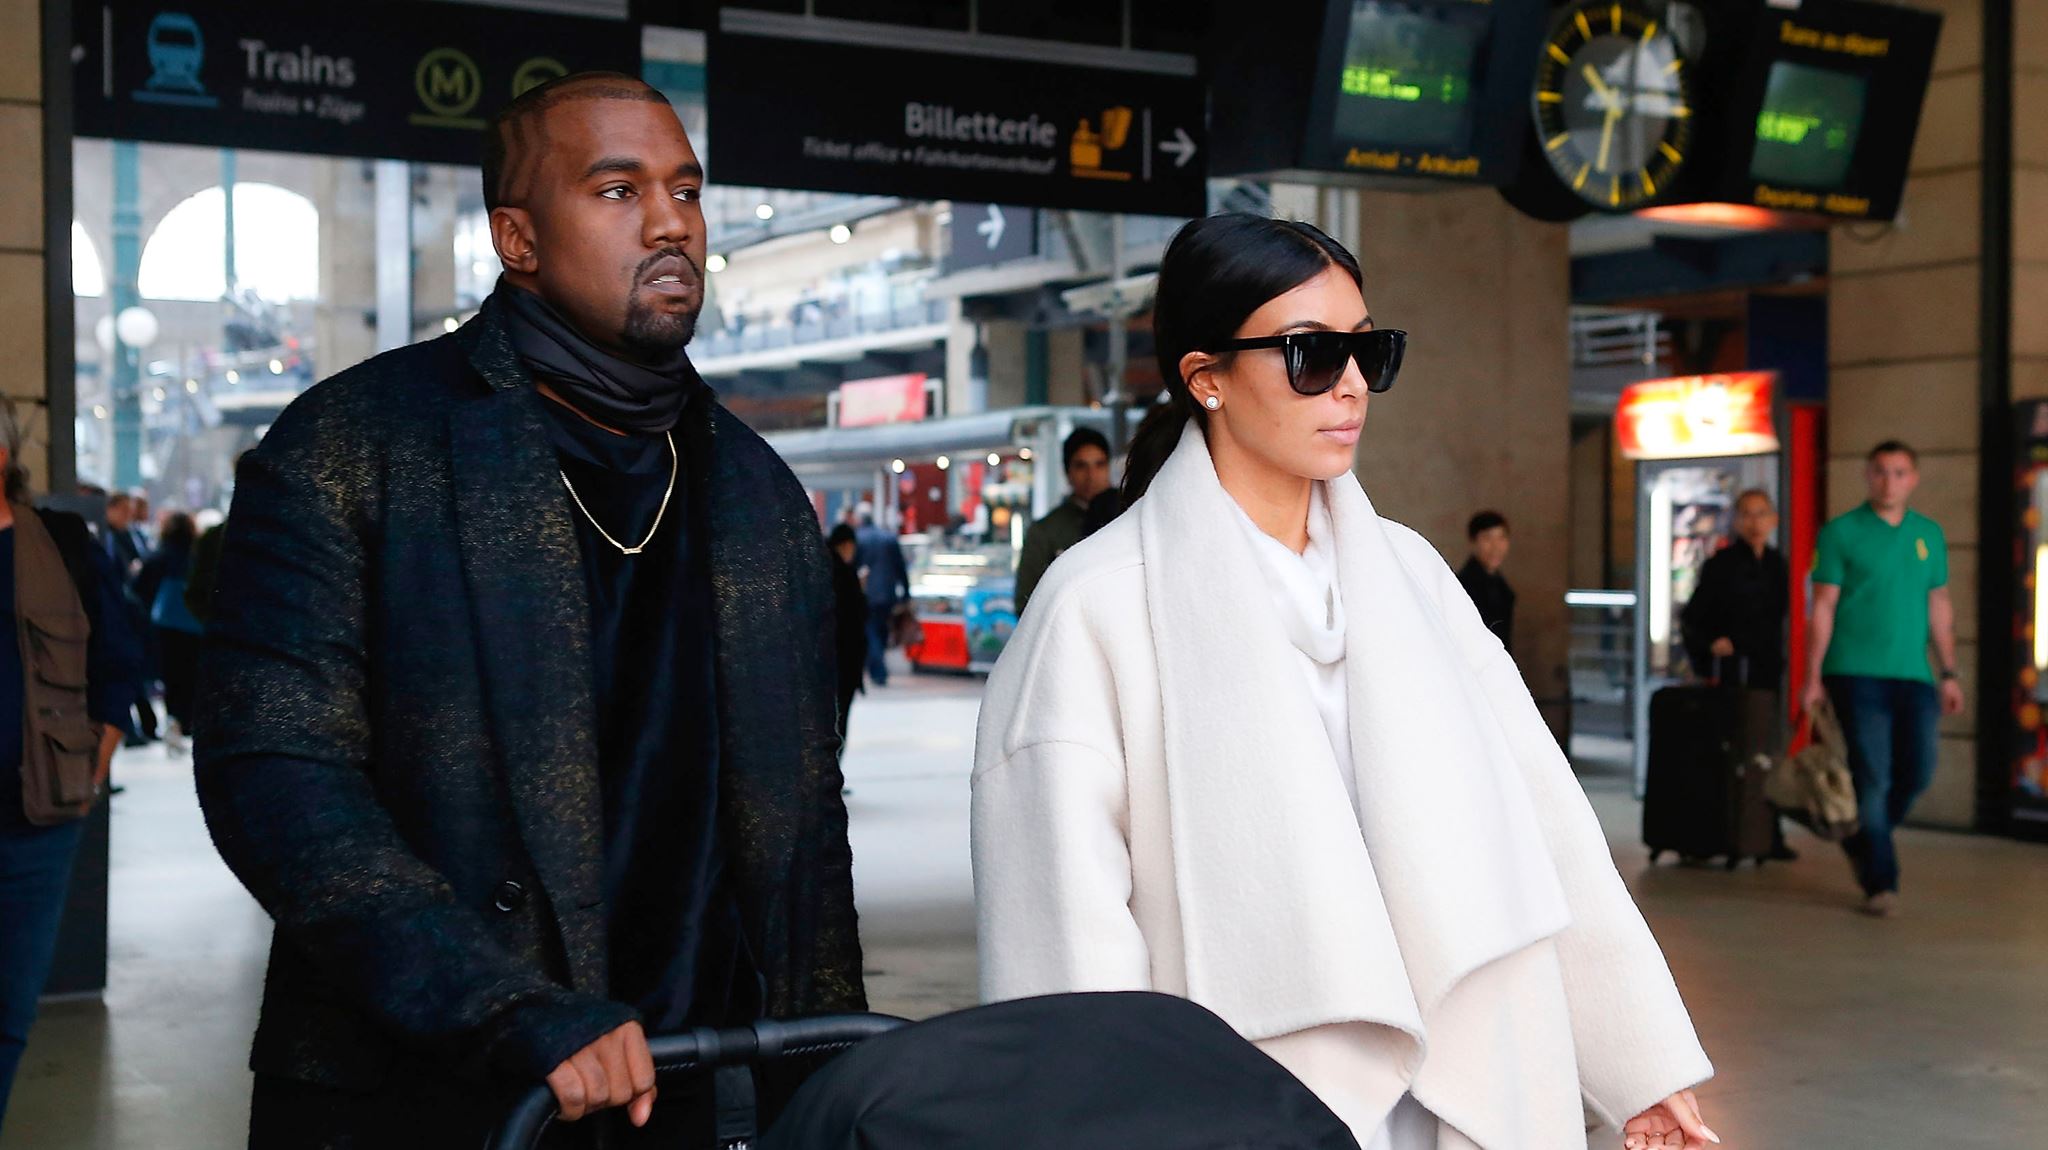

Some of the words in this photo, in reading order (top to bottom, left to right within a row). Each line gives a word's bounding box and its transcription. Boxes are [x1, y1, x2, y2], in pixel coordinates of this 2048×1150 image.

[239, 38, 356, 88] Trains
[431, 63, 466, 99] M
[905, 102, 1057, 148] Billetterie
